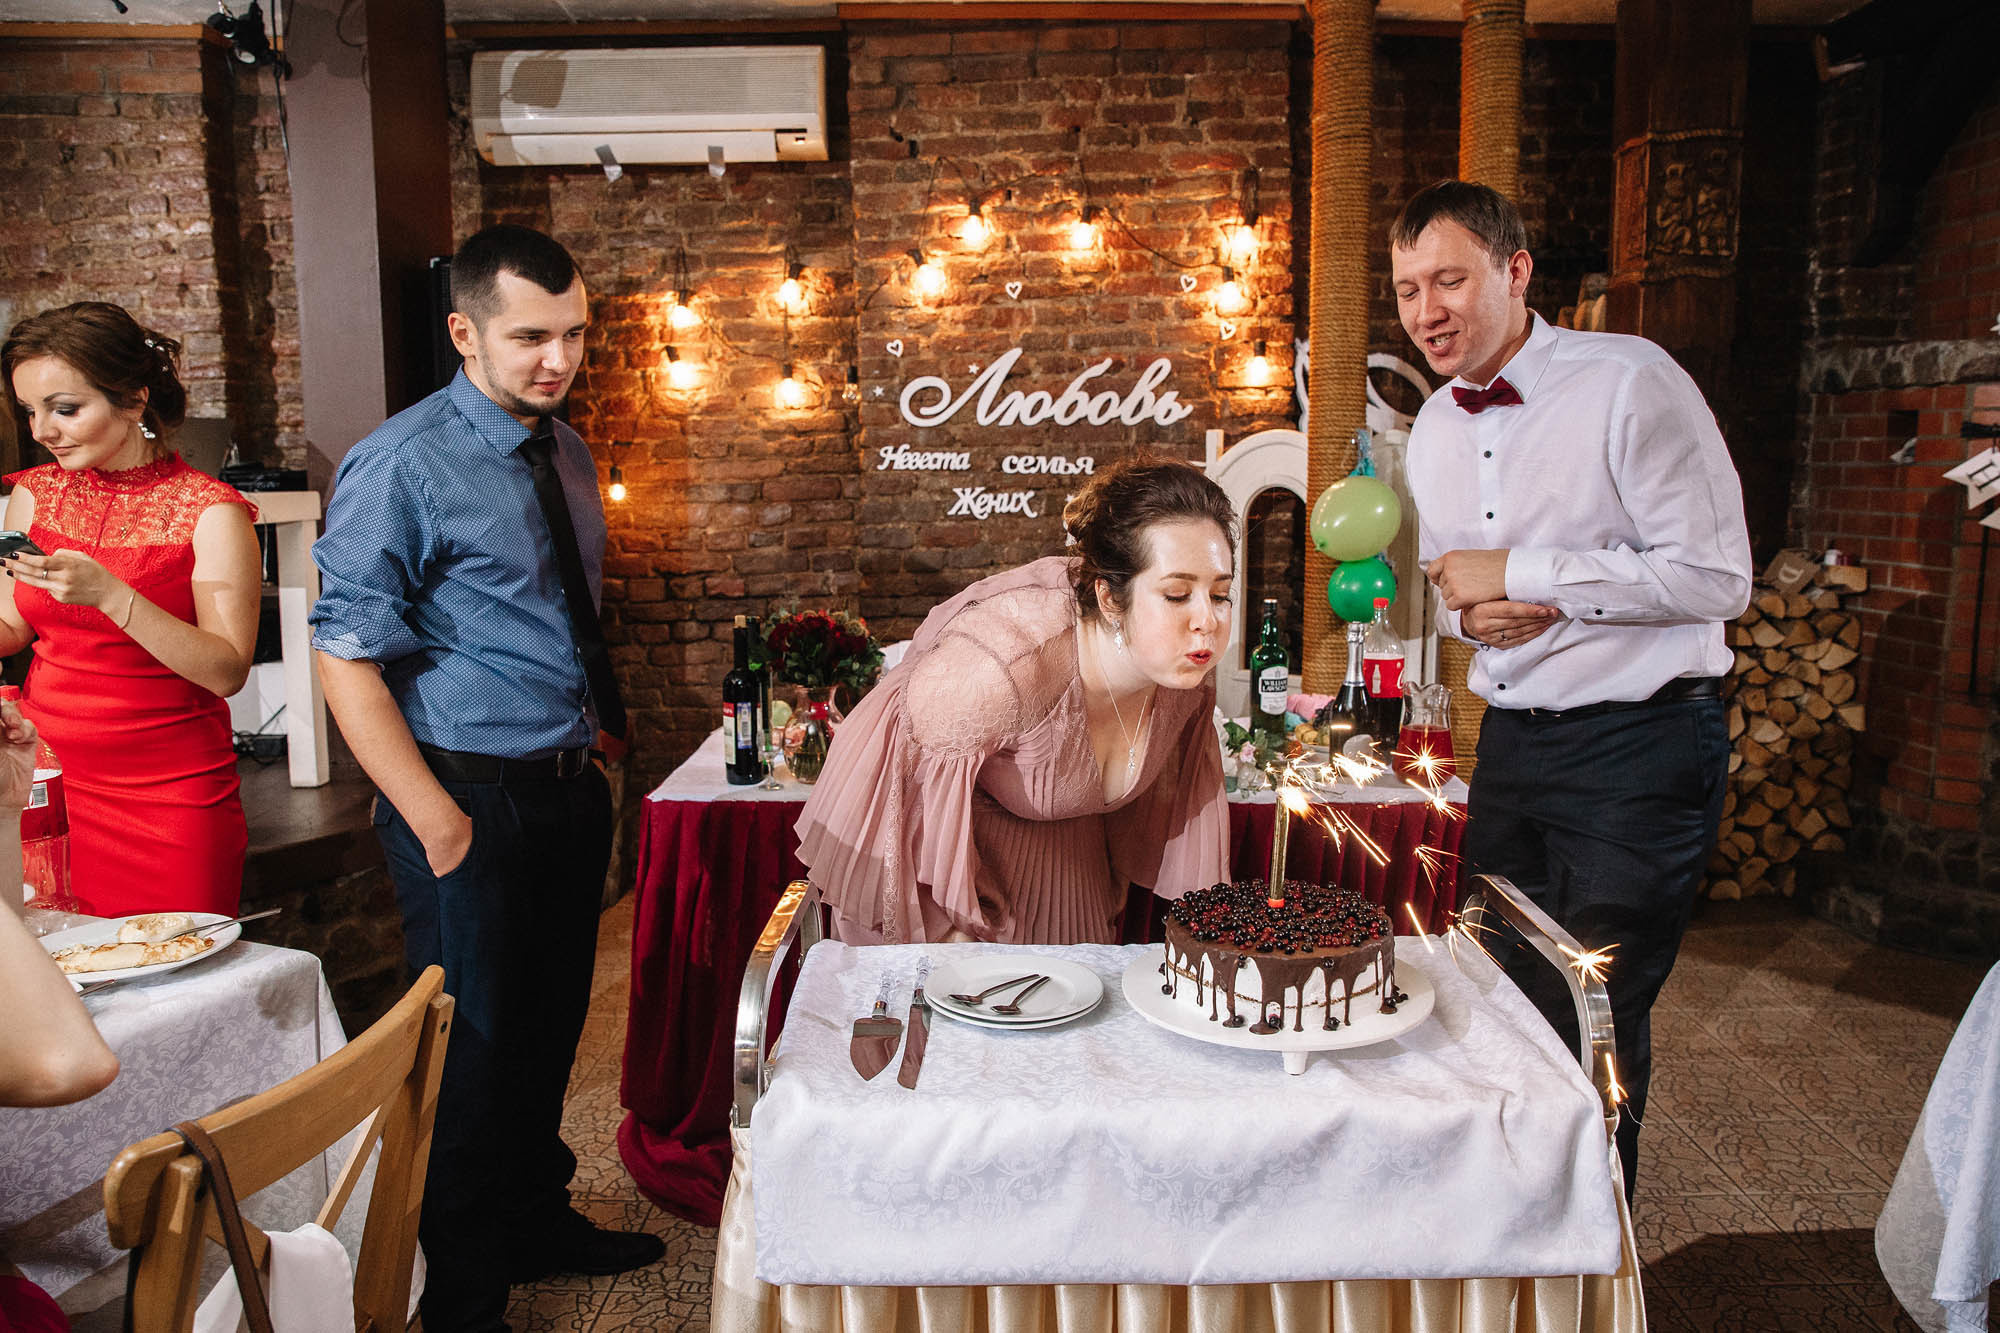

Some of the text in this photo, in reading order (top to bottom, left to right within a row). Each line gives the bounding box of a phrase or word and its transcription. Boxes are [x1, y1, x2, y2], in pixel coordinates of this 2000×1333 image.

[900, 347, 1194, 427] Любовь
[877, 443, 971, 471] Невеста
[1001, 454, 1095, 475] семья
[947, 486, 1038, 520] Жених
